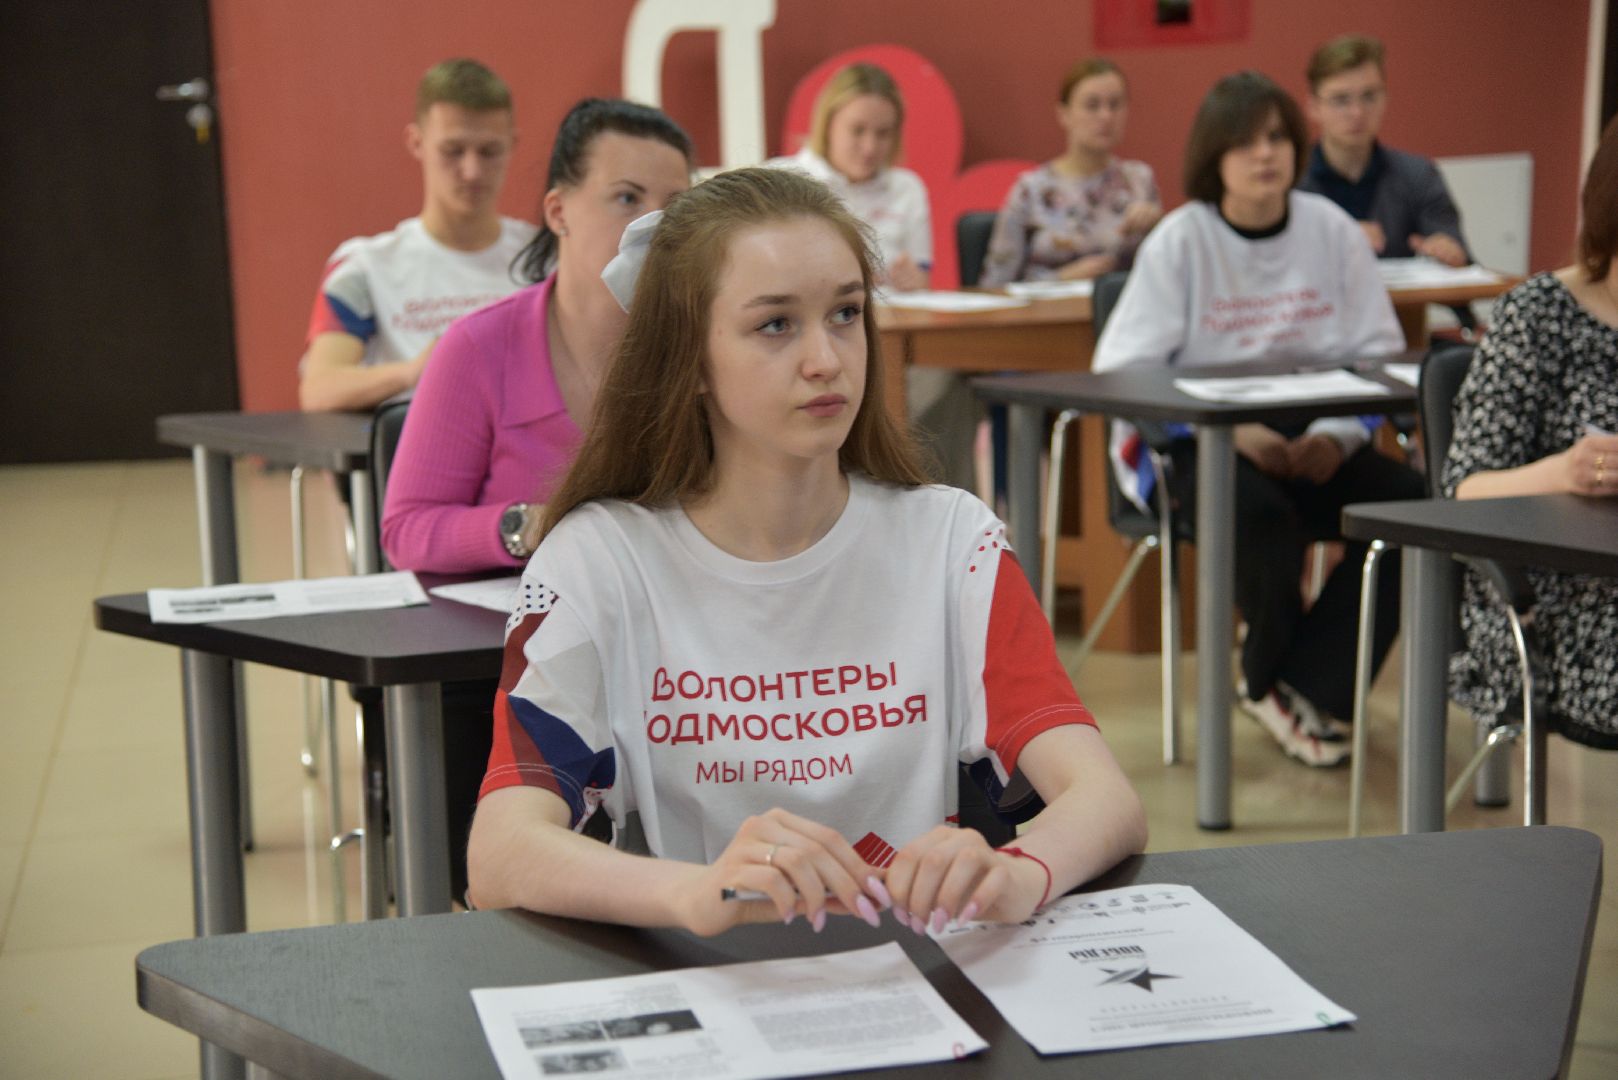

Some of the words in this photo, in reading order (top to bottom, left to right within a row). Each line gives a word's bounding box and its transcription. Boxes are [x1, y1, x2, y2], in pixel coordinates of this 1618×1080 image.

[651, 661, 897, 702] ВОЛОНТЕРЫ
[643, 694, 927, 745] ОДМОСКОВЬЯ
[696, 761, 744, 784] МЫ
[754, 753, 853, 785] РЯДОМ
